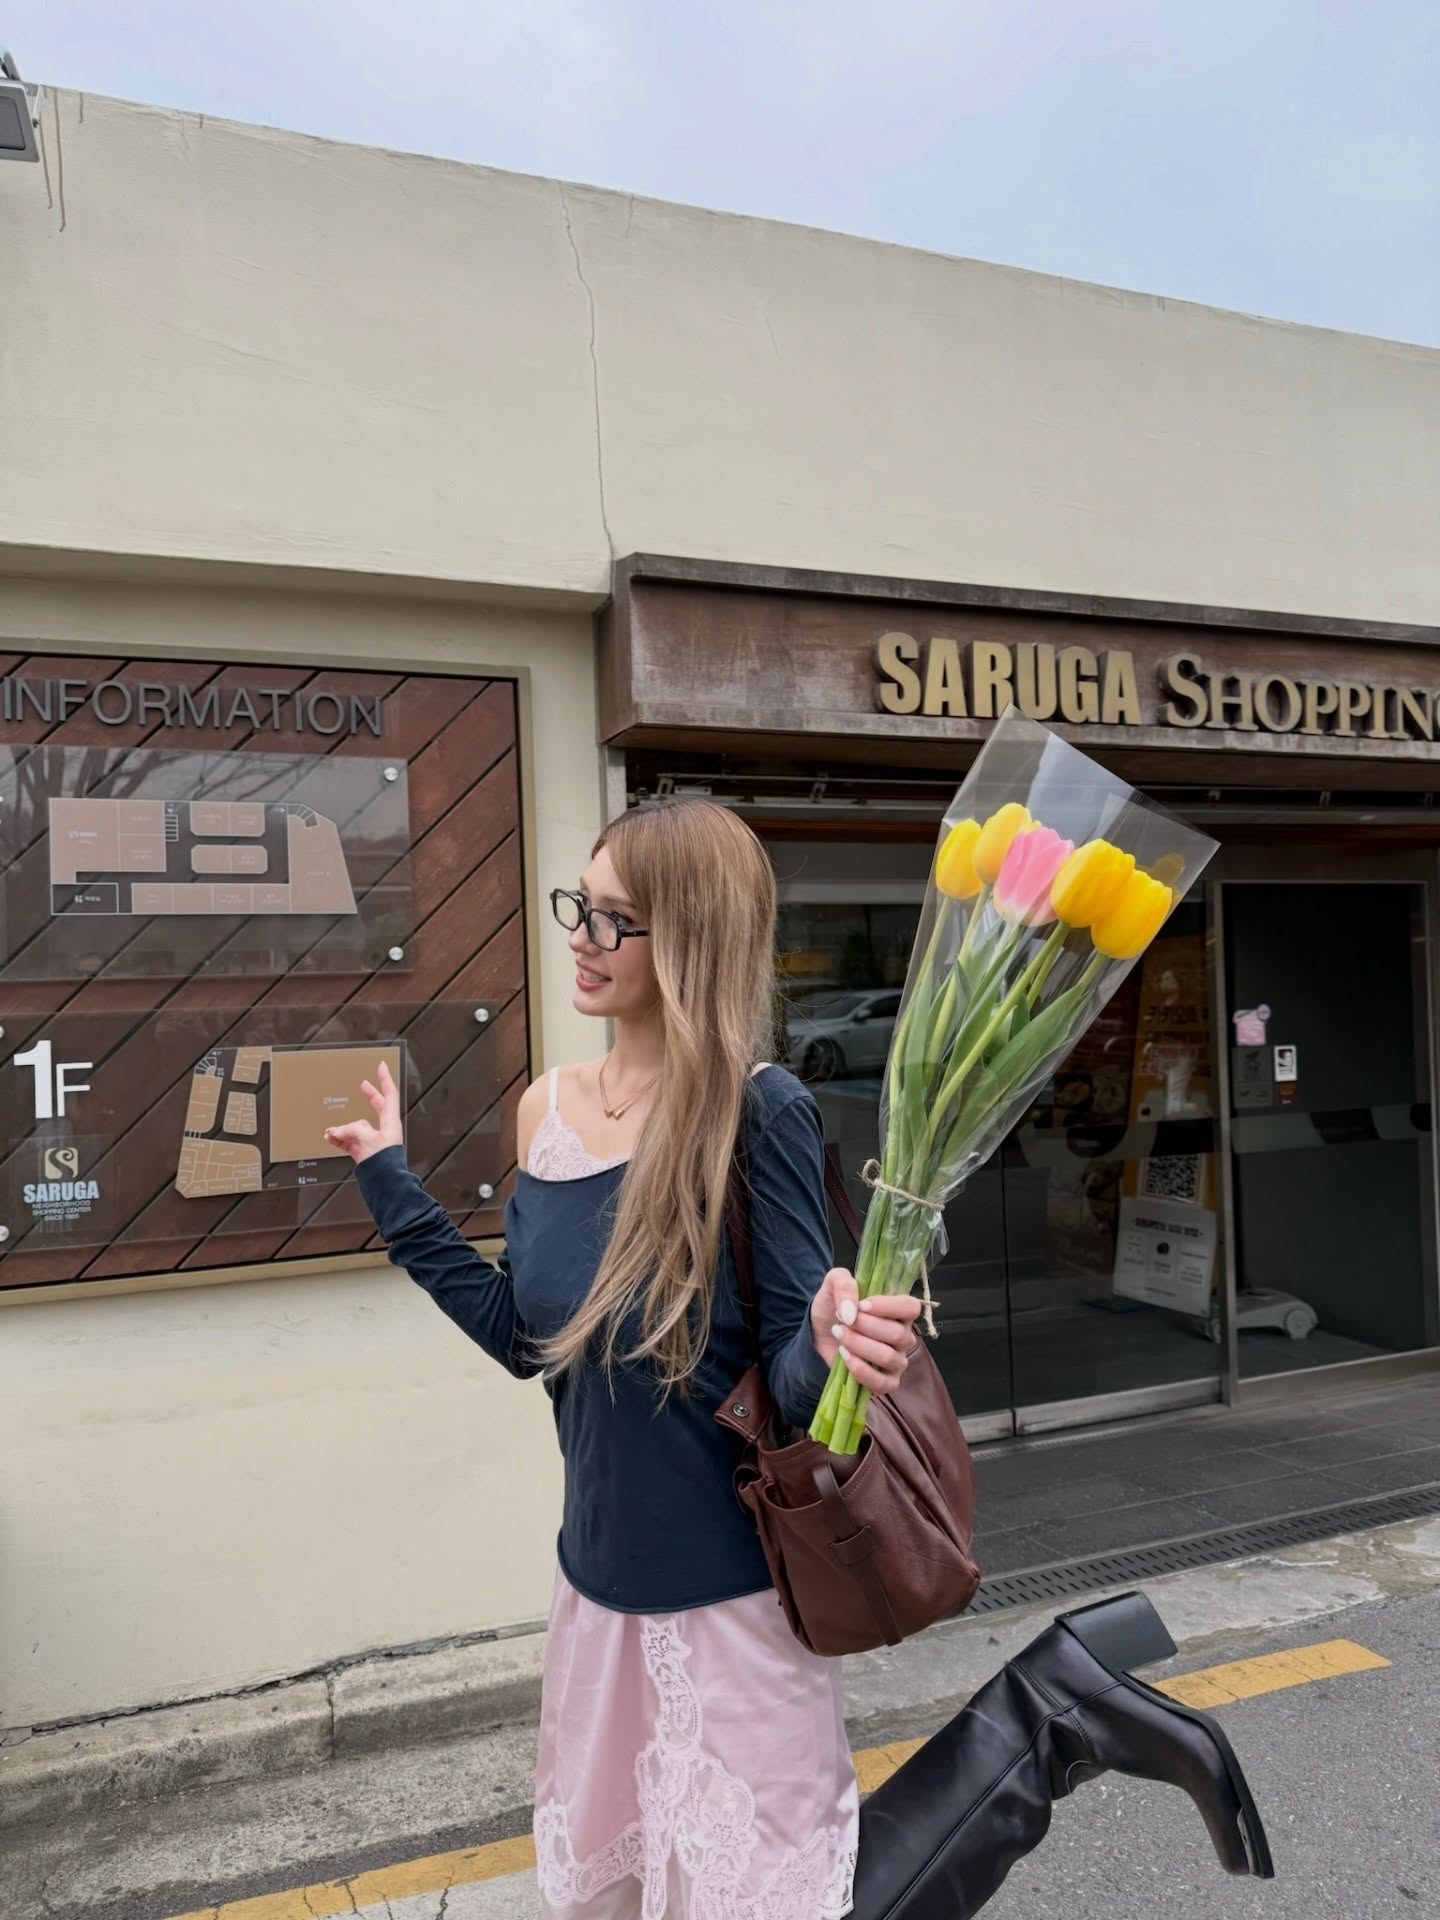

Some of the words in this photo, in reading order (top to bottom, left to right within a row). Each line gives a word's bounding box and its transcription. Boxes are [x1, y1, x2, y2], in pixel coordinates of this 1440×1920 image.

[3, 676, 383, 736] INFORMATION
[876, 632, 1142, 726] SARUGA
[1164, 653, 1440, 740] SHOPPIN
[13, 1040, 93, 1119] 1F
[23, 1180, 100, 1203] SARUGA
[32, 1208, 65, 1216] SHOPPING
